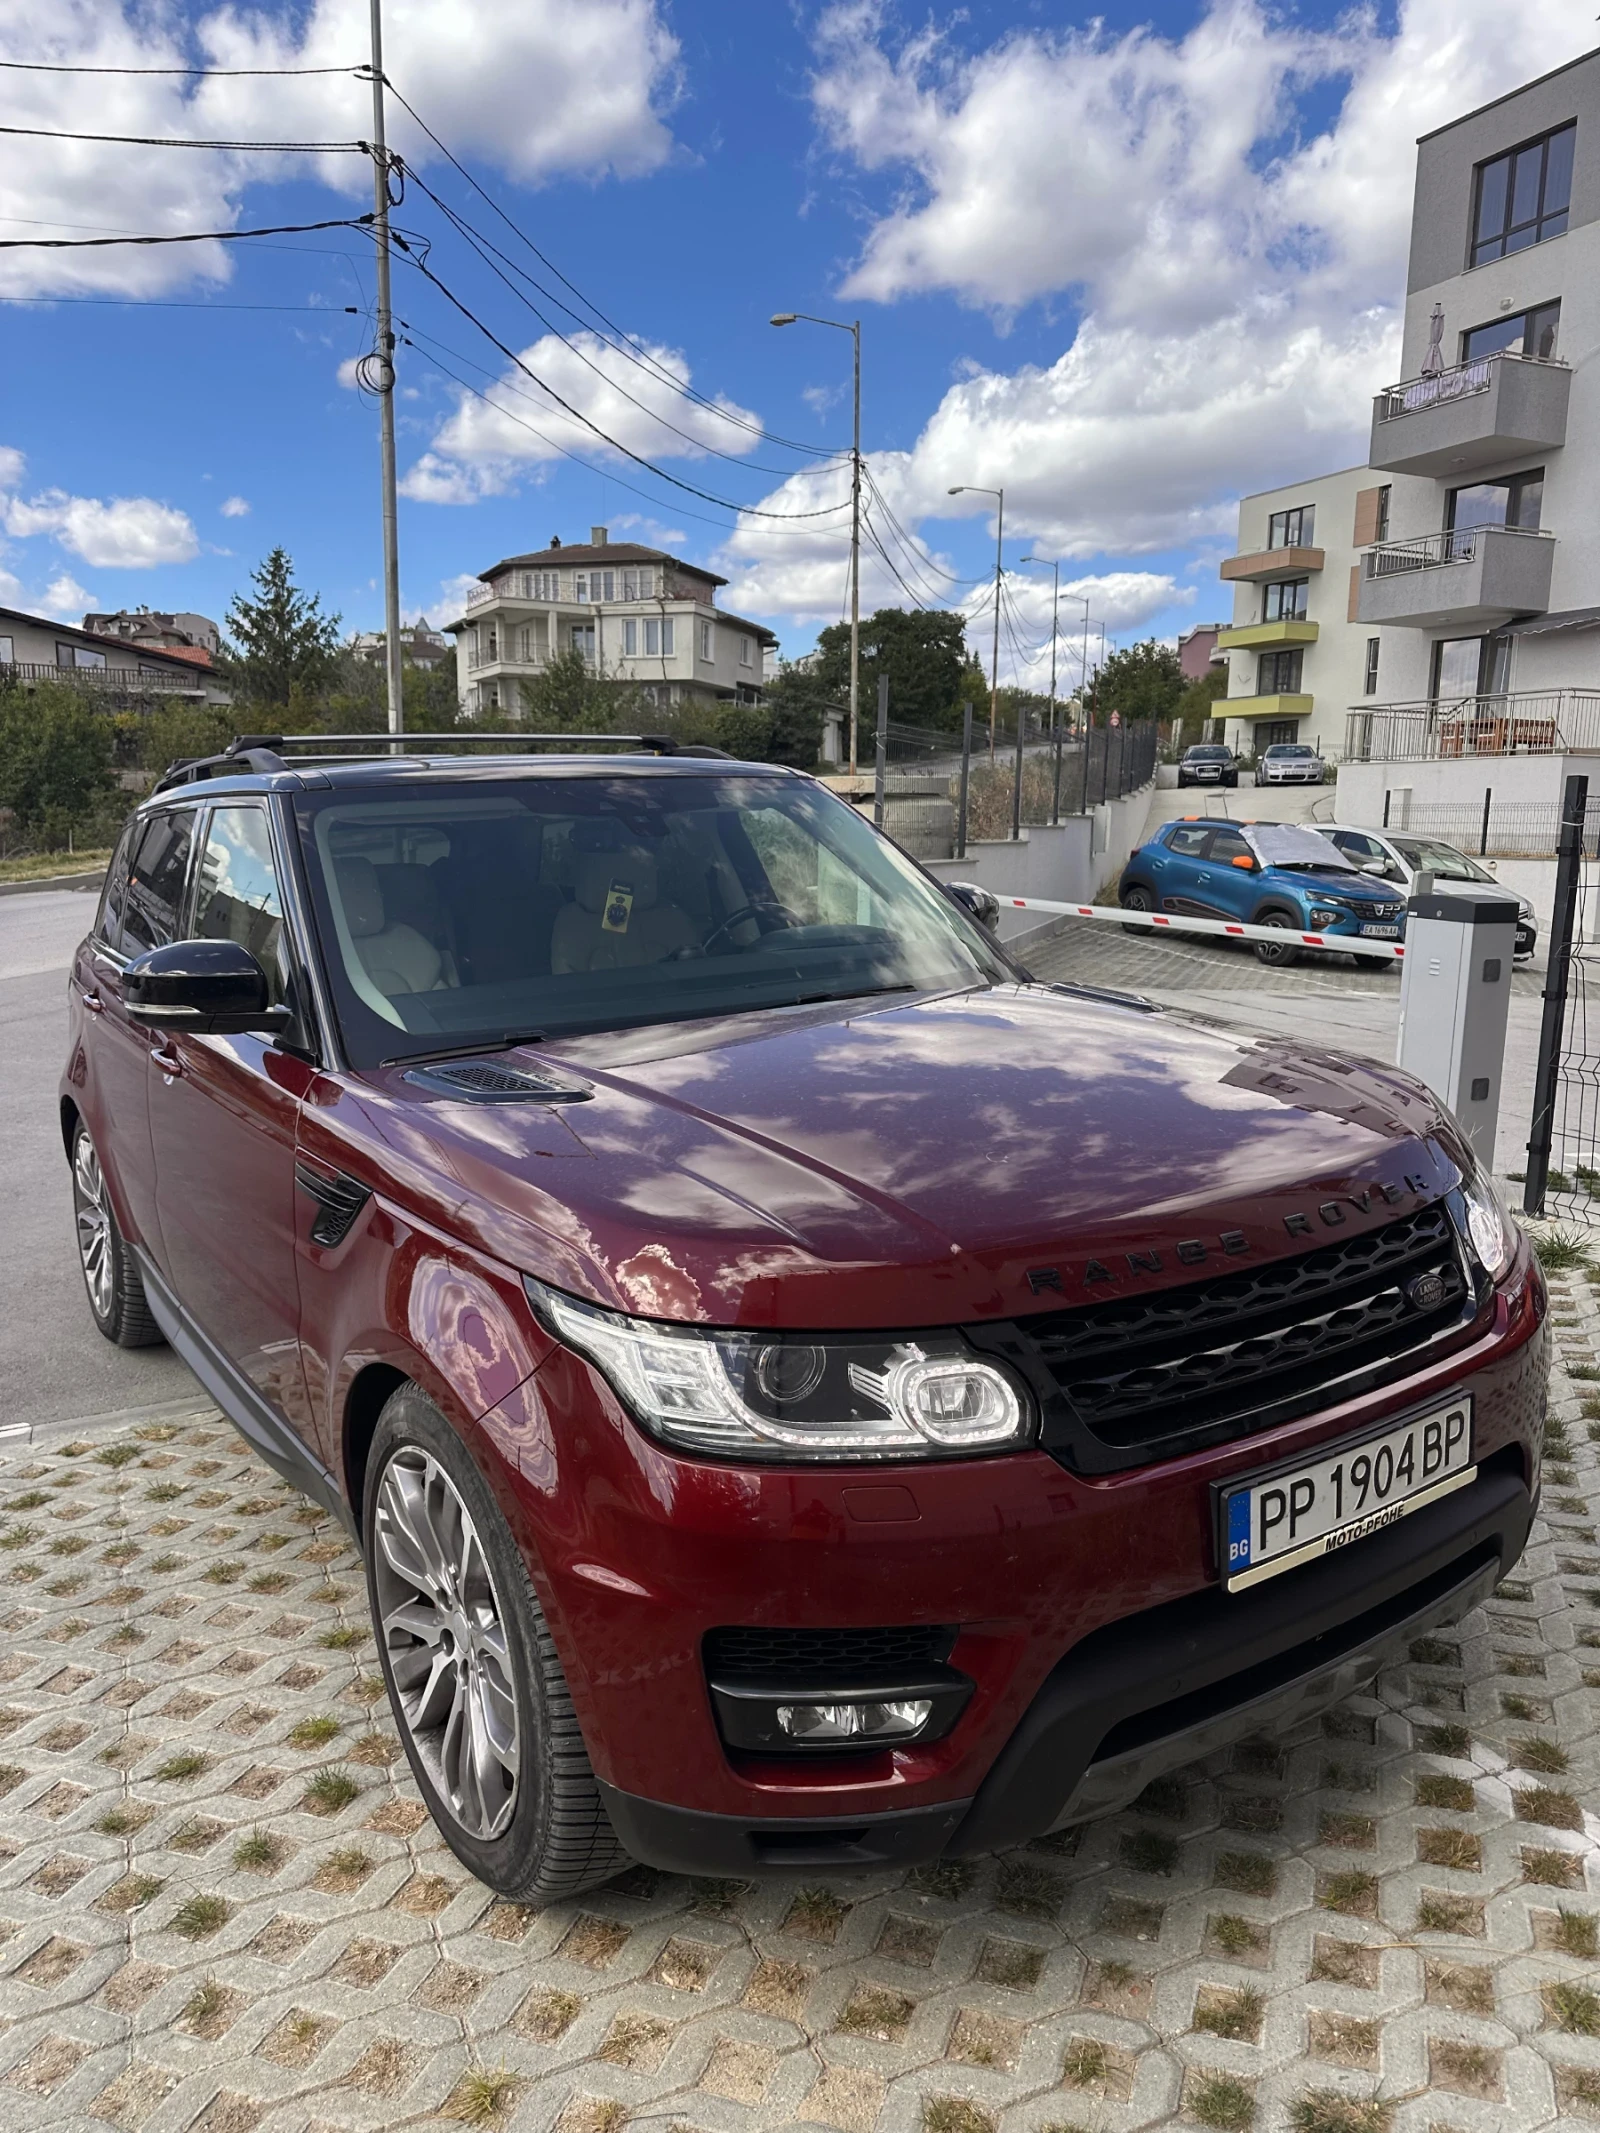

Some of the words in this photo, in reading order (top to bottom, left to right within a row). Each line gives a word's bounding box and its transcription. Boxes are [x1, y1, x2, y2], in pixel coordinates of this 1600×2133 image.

[1026, 1229, 1249, 1296] RANGE
[1283, 1174, 1429, 1239] ROVER
[1420, 1282, 1436, 1296] LAND
[1423, 1288, 1441, 1304] ROVER
[1259, 1477, 1316, 1551] PP
[1330, 1432, 1415, 1520] 1904
[1422, 1410, 1465, 1478] BP
[1324, 1503, 1405, 1552] MOTO-PFOHE
[1229, 1538, 1249, 1561] BG
